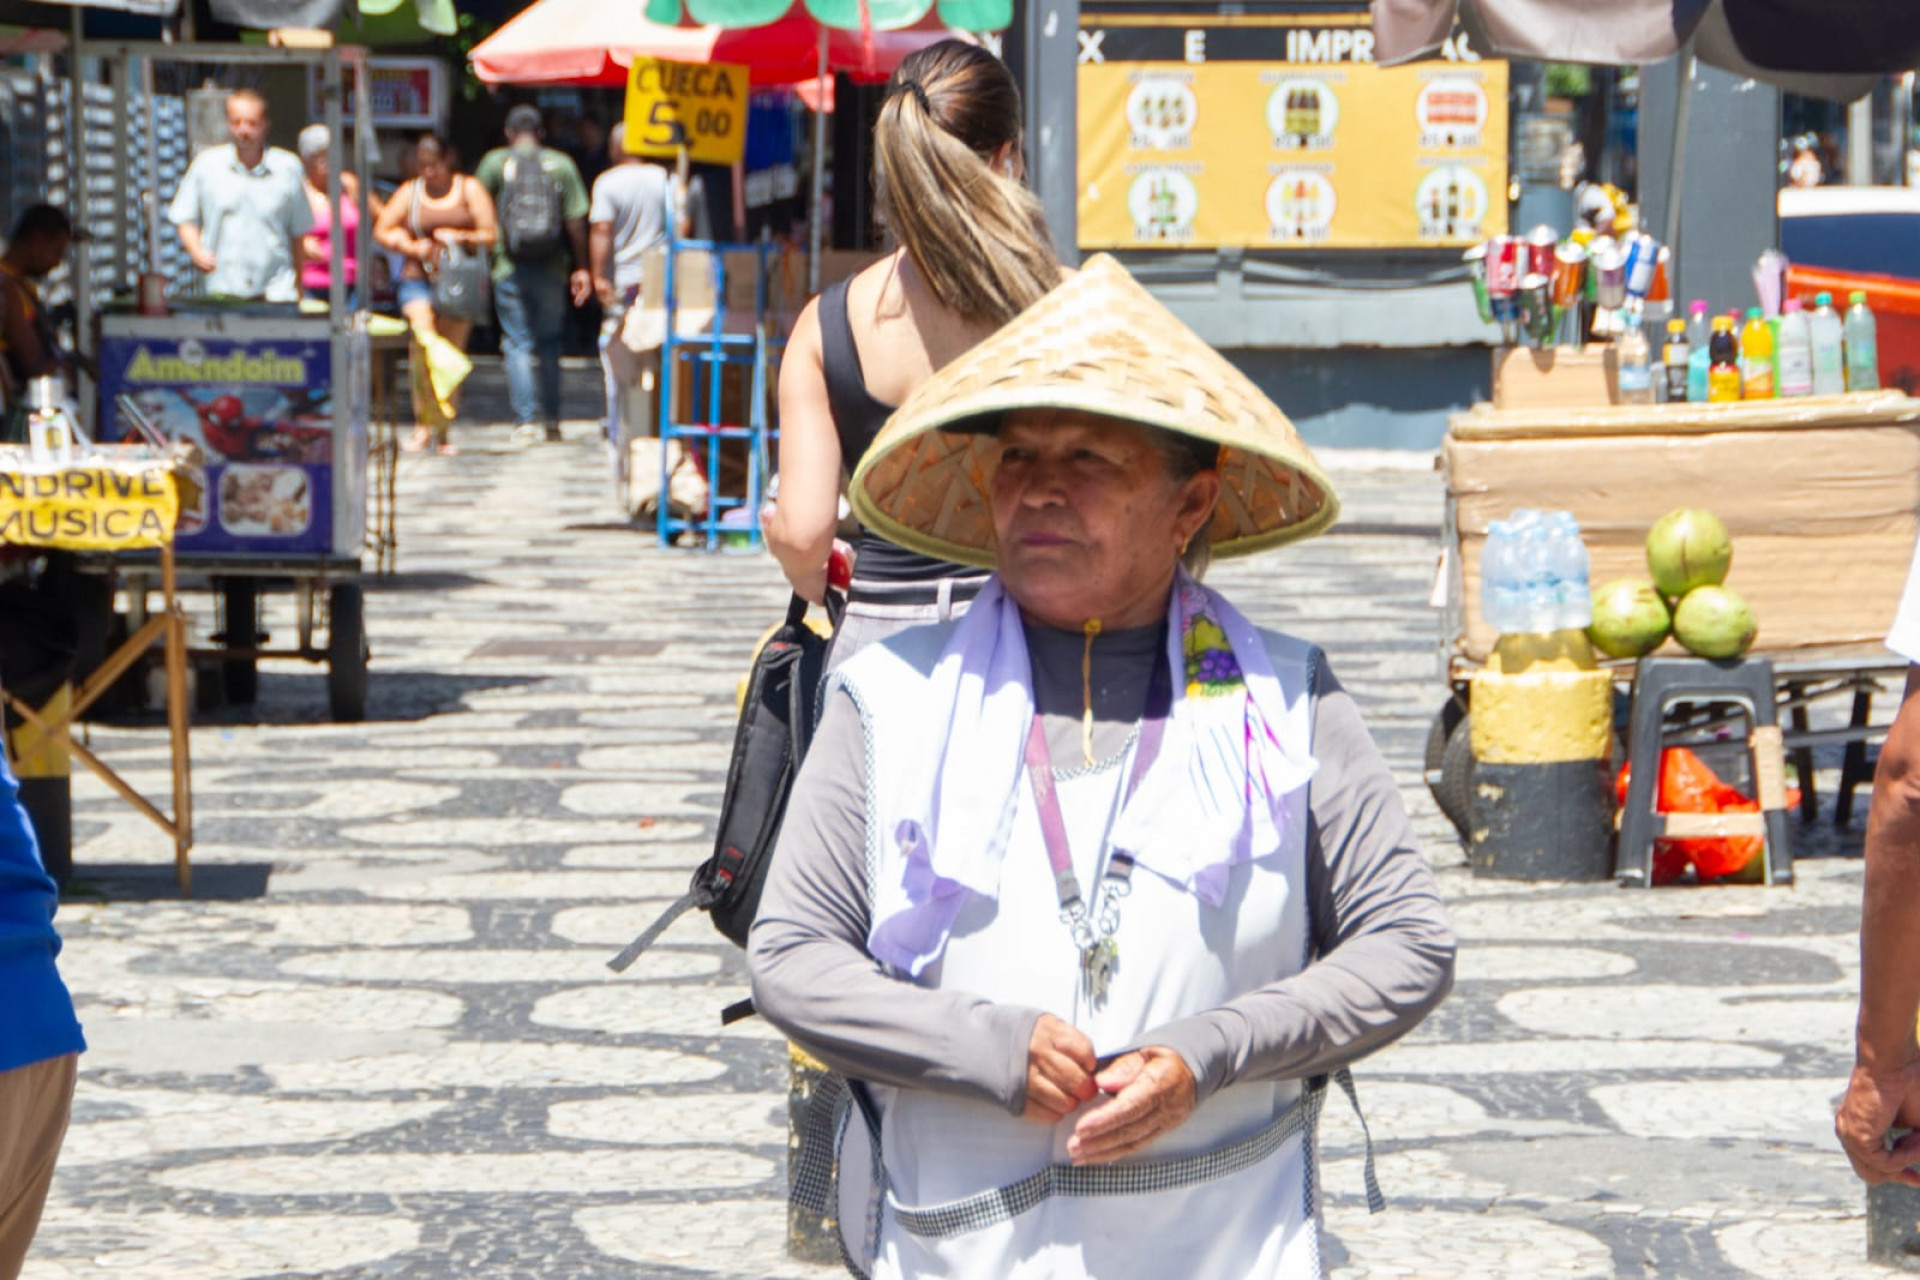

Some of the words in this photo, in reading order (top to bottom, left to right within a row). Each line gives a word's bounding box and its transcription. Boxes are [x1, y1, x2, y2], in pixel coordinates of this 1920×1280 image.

[1184, 29, 1207, 63] E
[635, 63, 736, 100] CUECA
[125, 344, 307, 383] Amendoim
